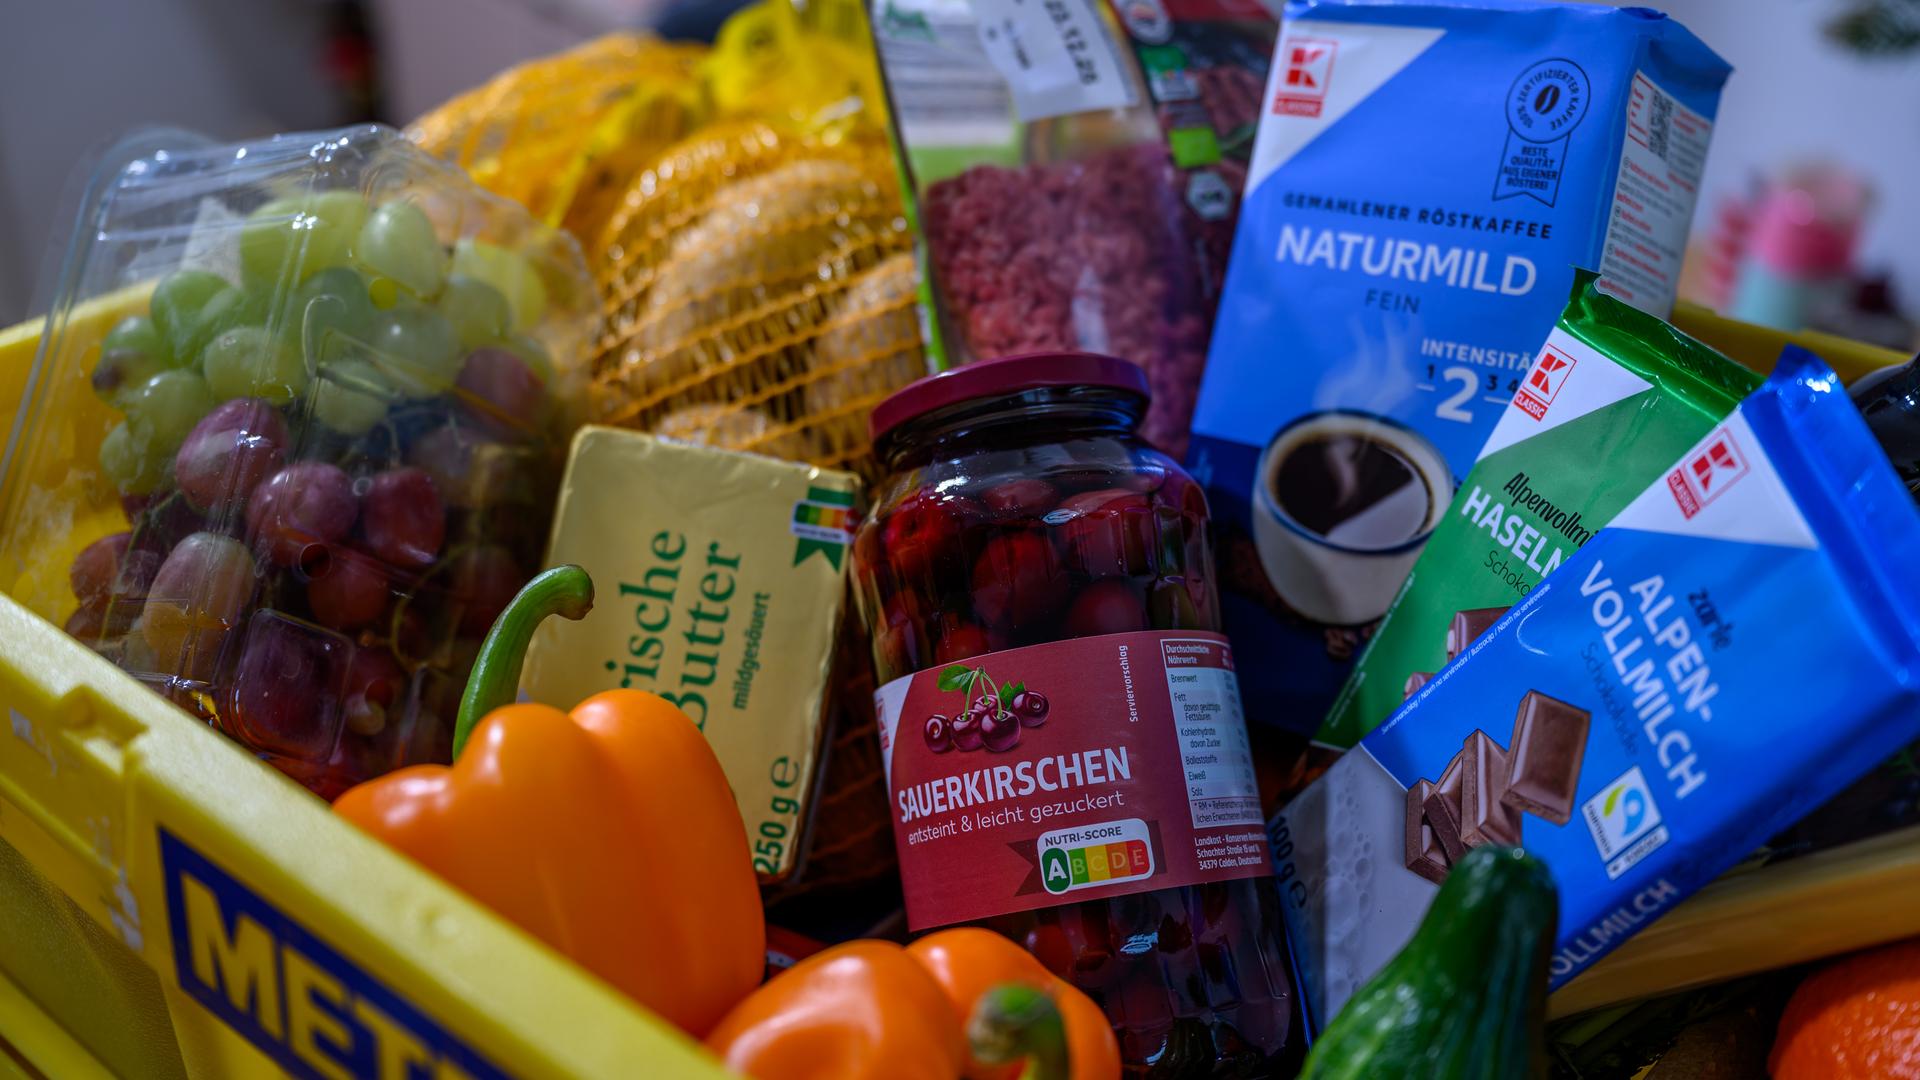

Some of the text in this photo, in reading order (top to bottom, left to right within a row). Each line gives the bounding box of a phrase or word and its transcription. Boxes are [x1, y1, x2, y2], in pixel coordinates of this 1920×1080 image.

[1549, 97, 1580, 131] KAFFEE
[1510, 156, 1556, 169] QUALITÄT
[1521, 146, 1549, 158] BESTE
[1503, 166, 1559, 181] AUS EIGENER
[1506, 177, 1550, 191] RÖSTEREI
[1282, 193, 1553, 240] GEMAHLENER RÖSTKAFFEE
[1276, 223, 1538, 298] NATURMILD
[1364, 288, 1421, 315] FEIN
[1420, 338, 1536, 372] INTENSITÄ
[1427, 363, 1436, 381] 1
[1435, 366, 1480, 424] 2
[1485, 373, 1499, 392] 3
[1514, 393, 1548, 420] CLASSIC
[606, 530, 687, 690] ische
[733, 592, 771, 711] mildgesäuert
[1629, 574, 1719, 723] ALPEN-
[1118, 645, 1139, 722] Serviervorschlag
[1170, 674, 1198, 684] Brennwert
[1580, 559, 1706, 800] VOLLMILCH
[1173, 692, 1187, 702] Fett
[898, 746, 1132, 824] SAUERKIRSCHEN
[1188, 770, 1206, 781] Eiweiß
[908, 789, 1125, 845] entsteint & leicht gezuckert
[753, 821, 787, 876] 250
[770, 795, 800, 817] g
[1045, 826, 1122, 847] NUTRI-SCORE
[1271, 815, 1295, 862] 100
[1047, 858, 1067, 882] A
[1199, 859, 1218, 870] 34379
[1279, 862, 1297, 884] g
[1549, 879, 1678, 982] OLLMILCH
[179, 867, 470, 1080] MET
